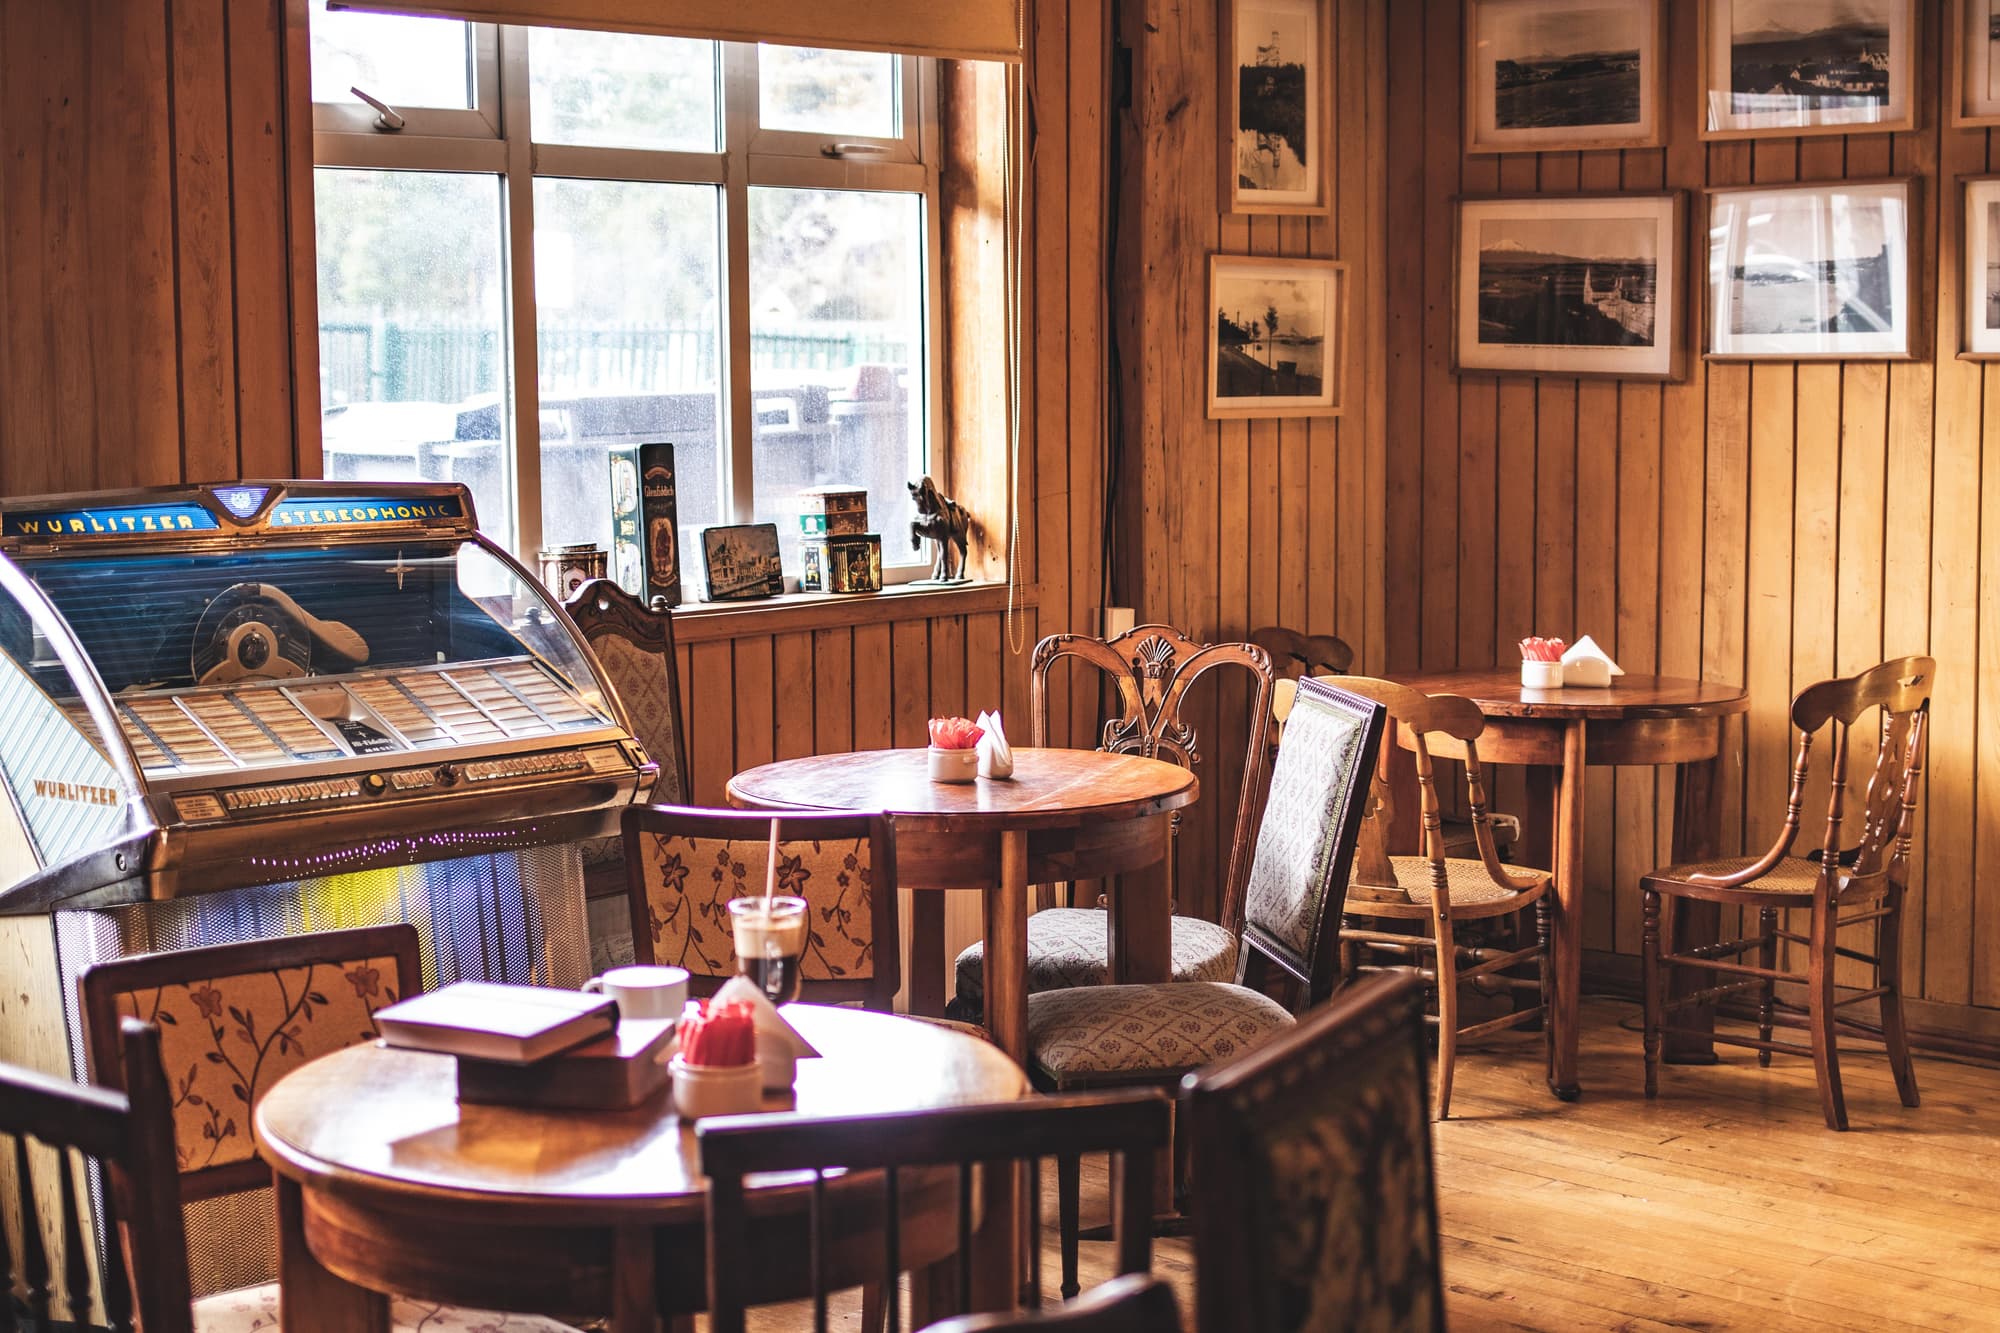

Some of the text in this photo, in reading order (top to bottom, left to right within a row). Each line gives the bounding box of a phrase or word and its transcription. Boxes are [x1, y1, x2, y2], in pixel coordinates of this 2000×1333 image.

[18, 504, 449, 534] WURLITZER STEREOPHONIC
[34, 779, 118, 806] WURLITZER
